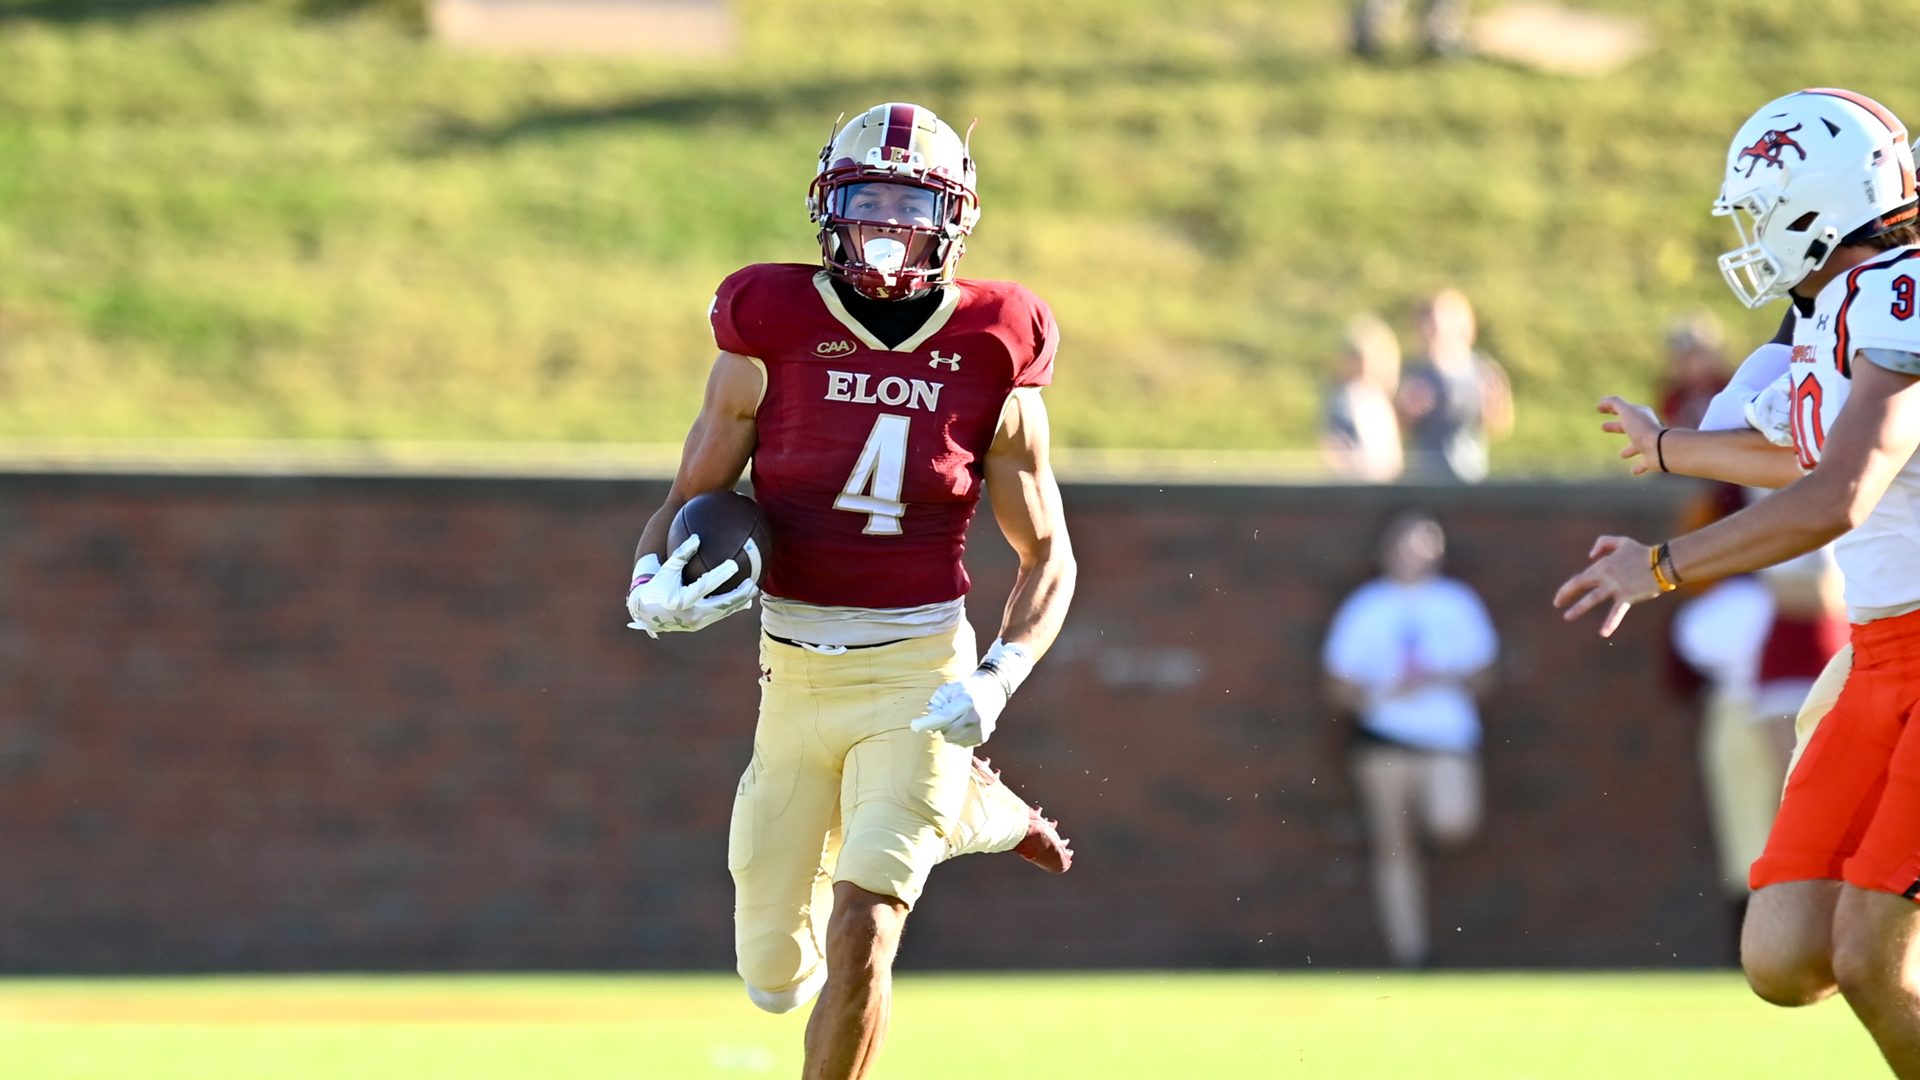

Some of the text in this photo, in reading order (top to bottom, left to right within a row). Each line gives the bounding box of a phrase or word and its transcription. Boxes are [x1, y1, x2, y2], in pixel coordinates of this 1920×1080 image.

[1890, 273, 1920, 321] 3
[816, 340, 850, 353] CAA
[823, 370, 945, 412] ELON
[831, 412, 911, 536] 4
